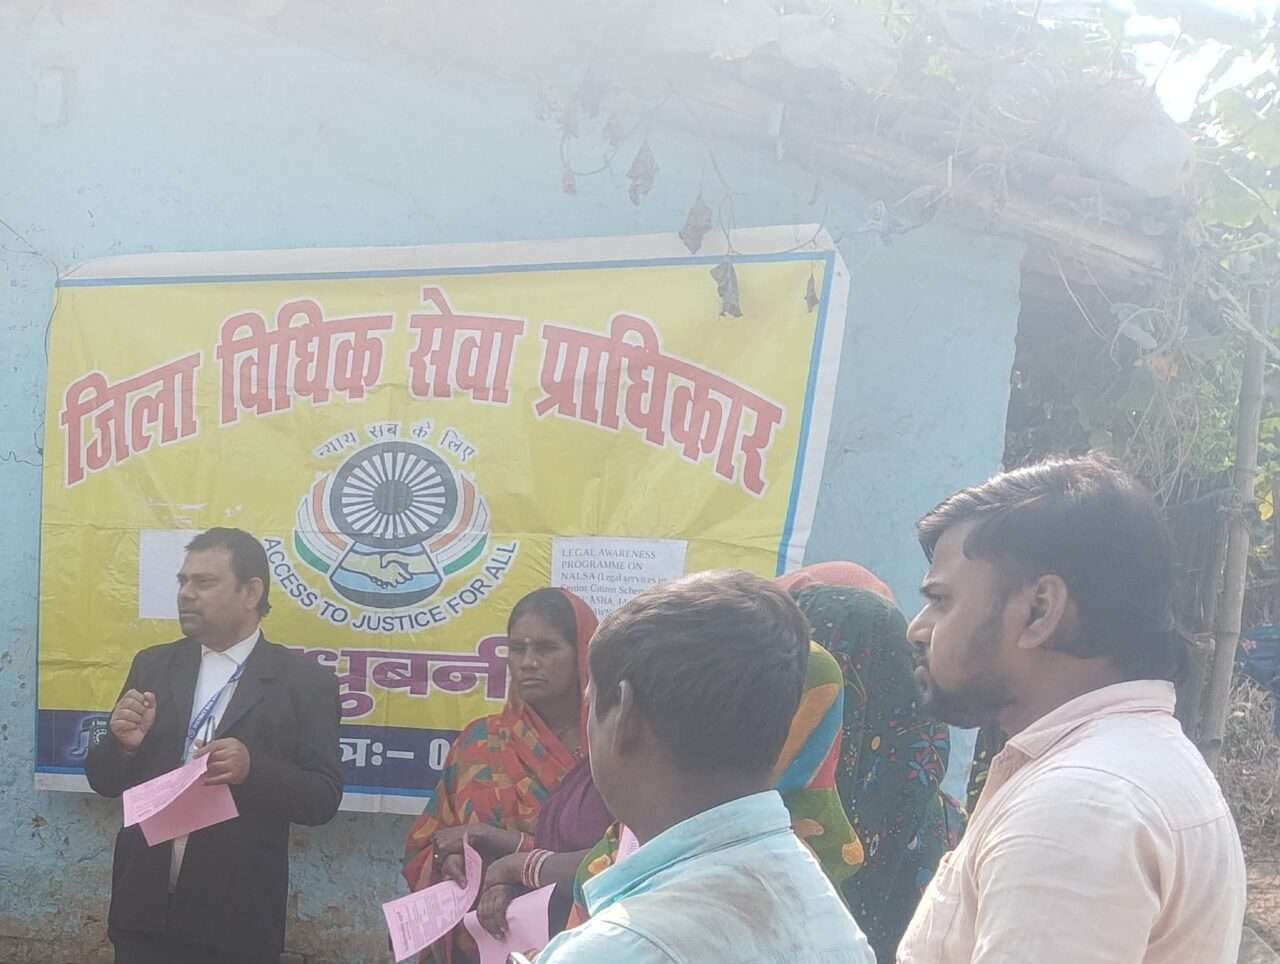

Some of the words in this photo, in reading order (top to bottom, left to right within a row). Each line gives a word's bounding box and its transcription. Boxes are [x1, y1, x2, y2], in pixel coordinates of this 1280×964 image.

[61, 352, 201, 486] जिला
[216, 299, 393, 425] विधिक
[410, 287, 525, 404] सेवा
[535, 314, 783, 496] प्राधिकार
[368, 424, 399, 438] सब
[440, 429, 476, 462] लिए
[561, 548, 598, 557] LEGAL
[599, 548, 657, 560] AWARENESS
[561, 559, 625, 570] PROGRAMME
[627, 561, 643, 571] ON
[264, 538, 318, 607] ACCESS
[321, 600, 348, 623] TO
[352, 606, 447, 632] JUSTICE
[447, 578, 487, 614] FOR
[485, 542, 518, 580] ALL
